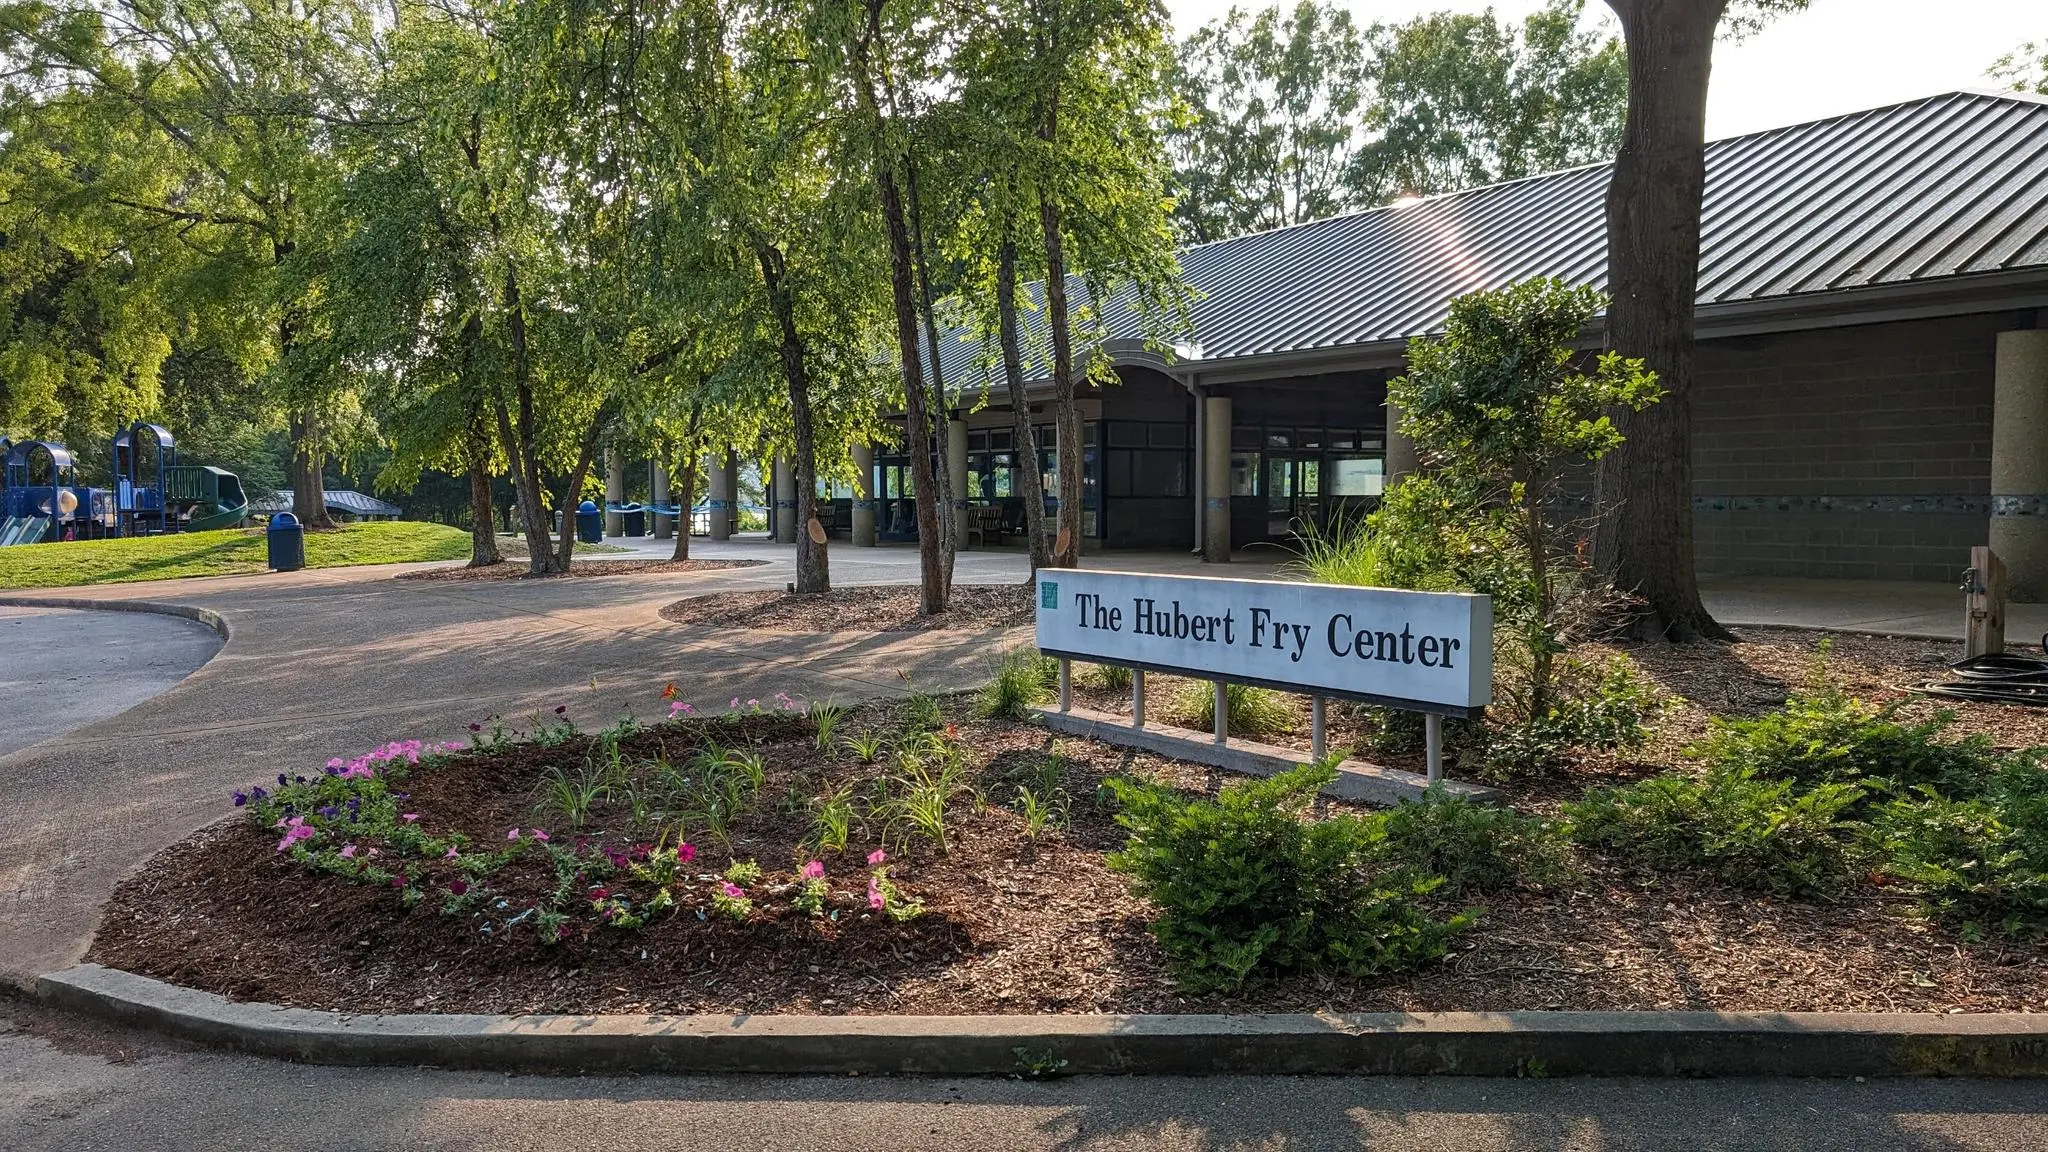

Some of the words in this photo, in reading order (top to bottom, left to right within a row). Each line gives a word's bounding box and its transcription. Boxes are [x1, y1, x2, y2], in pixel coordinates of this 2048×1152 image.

[1075, 593, 1122, 632] The
[1133, 597, 1235, 645] Hubert
[1249, 607, 1312, 663] Fry
[1328, 613, 1461, 669] Center
